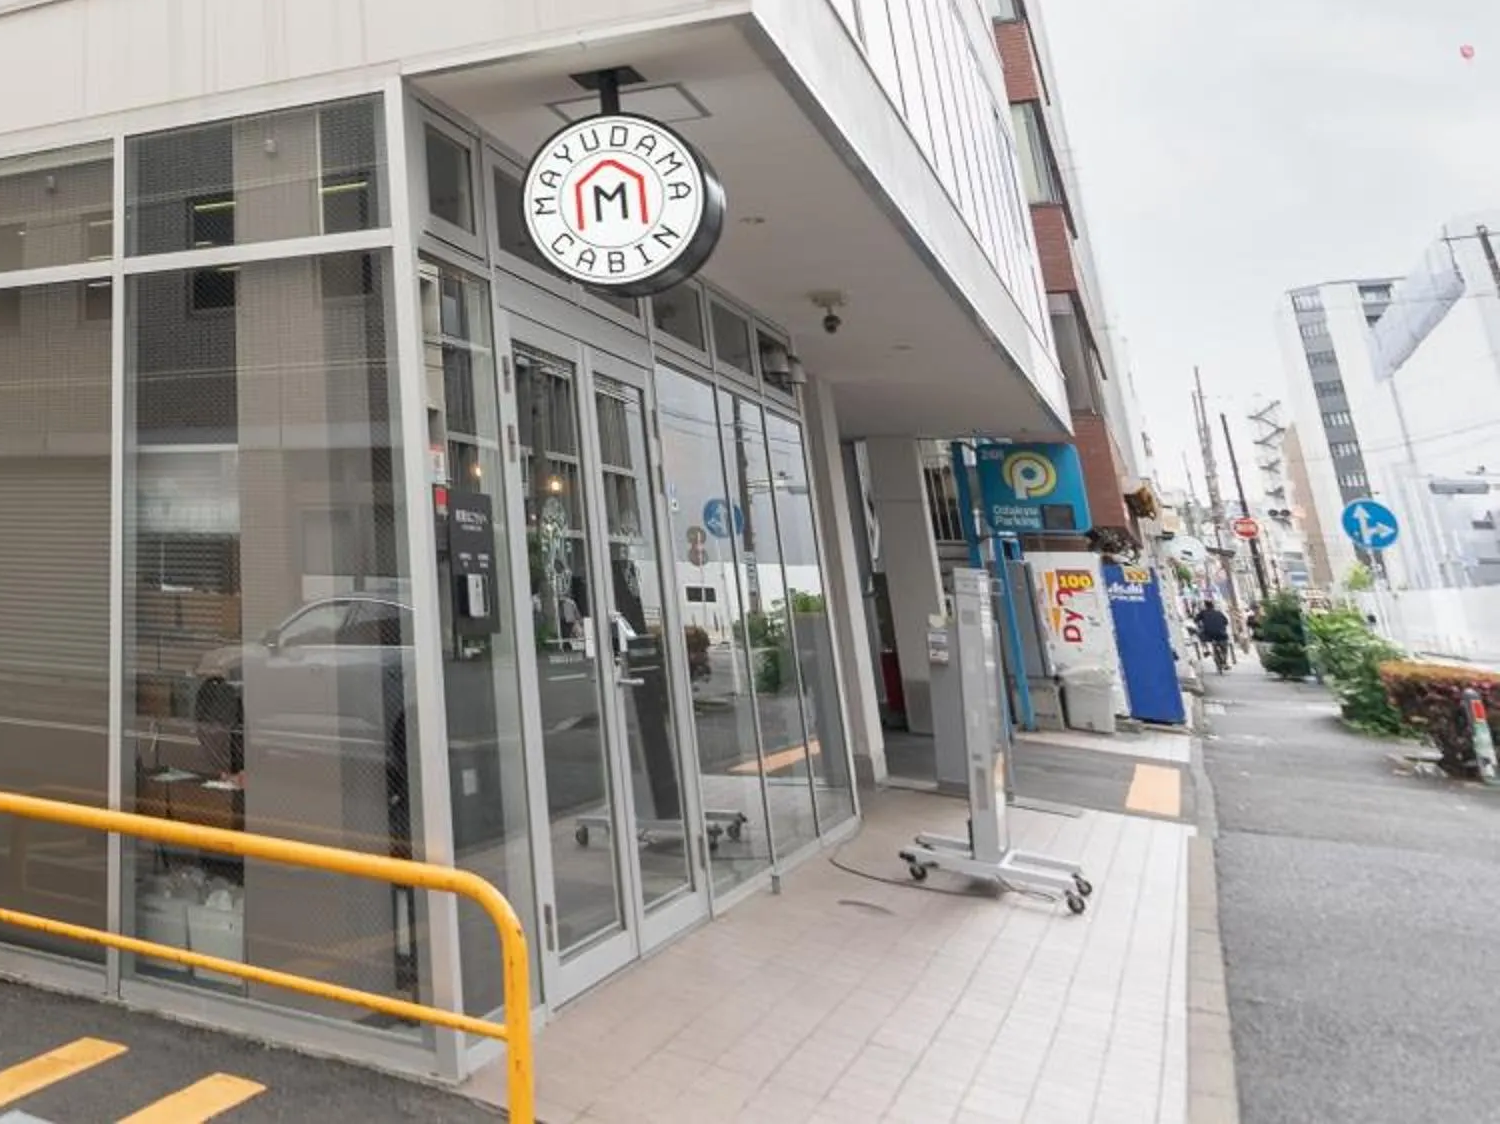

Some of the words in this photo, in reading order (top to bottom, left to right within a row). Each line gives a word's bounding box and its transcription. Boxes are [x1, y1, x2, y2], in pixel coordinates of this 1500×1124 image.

[534, 126, 692, 215] MAYUDAMA
[593, 180, 629, 222] M
[551, 225, 681, 274] CABIN
